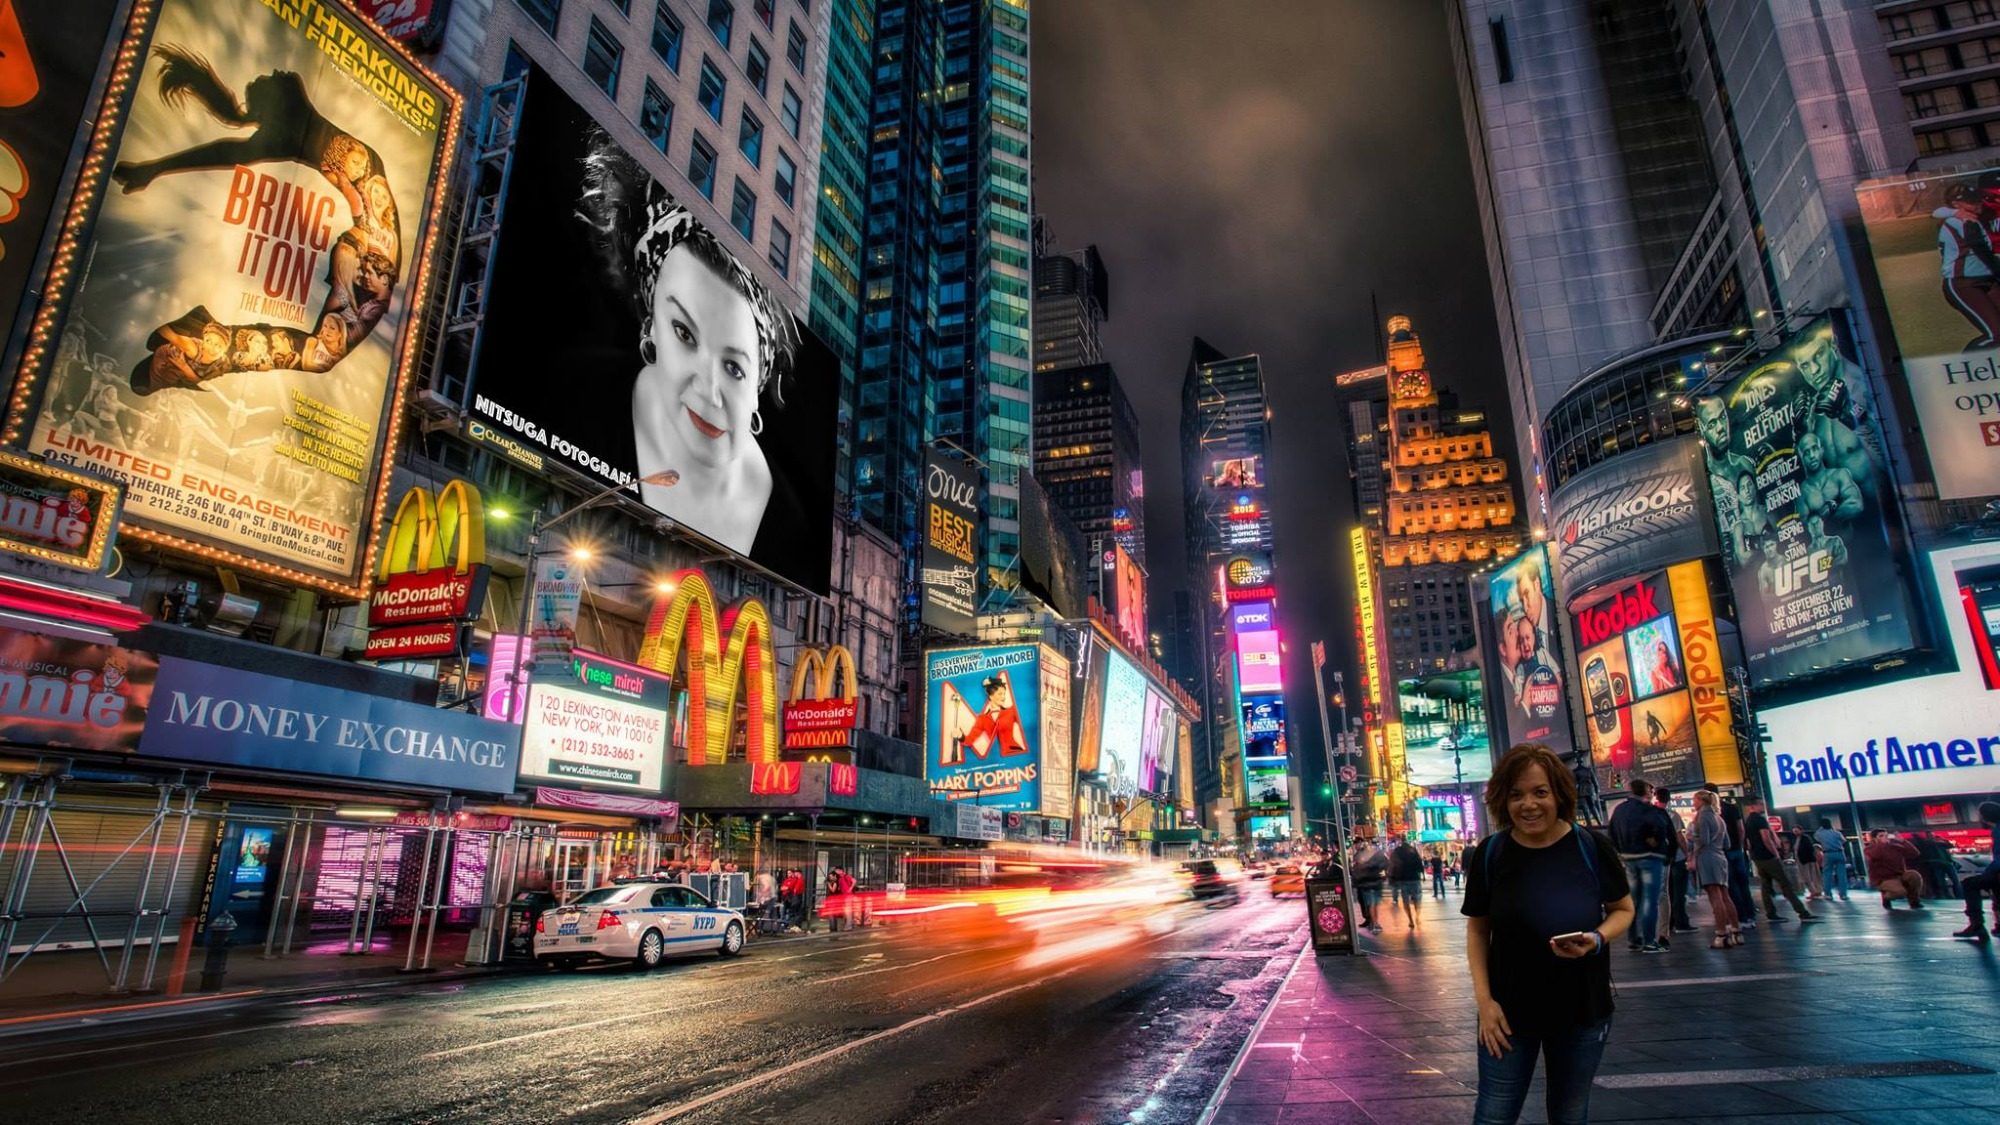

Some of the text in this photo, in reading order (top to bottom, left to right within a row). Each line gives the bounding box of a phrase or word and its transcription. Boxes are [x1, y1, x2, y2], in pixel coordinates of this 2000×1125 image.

[293, 0, 436, 117] THTAKING
[331, 62, 422, 137] THE NEW YORK TIMES
[223, 164, 335, 252] BRING
[237, 232, 318, 305] IT ON
[240, 292, 305, 324] THE MUSICAL
[1942, 357, 2000, 385] Hel
[292, 388, 370, 432] The new musical from
[295, 402, 312, 420] Tony
[1744, 383, 1776, 412] JONES
[283, 415, 316, 436] creators
[317, 430, 326, 439] of
[326, 433, 357, 451] AVENUE
[1743, 404, 1790, 448] BELFORT
[275, 443, 291, 457] and
[293, 448, 316, 466] NEXT
[316, 457, 328, 470] TO
[302, 437, 364, 470] IN THE HEIGHTS
[475, 394, 639, 494] NITSUGA FOTOGRAFÍA
[47, 430, 349, 540] LIMITED ENGAGEMENT
[1756, 455, 1800, 490] BENAVIDEZ
[81, 459, 128, 483] JAMES
[130, 475, 184, 503] THEATRE,
[186, 493, 209, 509] 246
[213, 501, 227, 516] W.
[229, 508, 251, 521] 44TH
[252, 515, 266, 529] ST.
[1765, 483, 1801, 512] JOHNSON
[930, 503, 975, 543] BEST
[1233, 505, 1255, 514] 2012
[1593, 520, 1630, 539] driving
[1632, 503, 1694, 526] emotion
[149, 495, 230, 529] 212.239.6200
[240, 524, 346, 566] BringItOnMusical.com
[930, 525, 972, 554] MUSICAL
[1231, 523, 1260, 531] TOSHIBA
[1353, 534, 1364, 557] THE
[1358, 563, 1368, 589] NEW
[1774, 550, 1829, 597] UFC
[1818, 555, 1834, 572] 152
[372, 582, 466, 607] McDonald's
[537, 581, 580, 592] BROADWAY
[1227, 588, 1275, 600] TOSHIBA
[1239, 575, 1264, 585] 2012
[384, 602, 452, 617] Restaurant
[1361, 596, 1373, 620] HTC
[1578, 581, 1661, 647] Kodak
[1769, 620, 1787, 634] LIVE
[1786, 617, 1798, 630] ON
[1797, 594, 1853, 624] PAY-PER-VIEW
[1787, 590, 1831, 616] SEPTEMBER
[1832, 584, 1845, 598] 22
[1244, 613, 1268, 623] TDK
[367, 633, 451, 650] OPEN 24 HOURS
[1365, 625, 1375, 648] EVO
[945, 652, 984, 666] EVERYTHING
[986, 656, 1004, 668] AND
[1006, 650, 1034, 664] MORE!
[1369, 654, 1378, 670] 4G
[1681, 619, 1728, 725] Kodak
[574, 659, 612, 685] hinese
[615, 673, 643, 694] mirch
[539, 694, 660, 731] 120 LEXINGTON AVENUE
[787, 708, 854, 720] McDonald's
[798, 719, 841, 727] Restaurant
[164, 691, 507, 769] MONEY EXCHANGE
[543, 712, 653, 744] NEW YORK, NY 10016
[561, 738, 635, 760] (212) 532-3663
[1776, 746, 1846, 786] Bank
[1849, 739, 1880, 777] of
[559, 764, 633, 781] www.chinesemirch.com
[930, 773, 971, 795] MARY
[974, 763, 1037, 788] POPPINS
[396, 816, 415, 826] TIMES
[198, 854, 219, 933] EXCHANGE
[693, 915, 716, 929] NYPD
